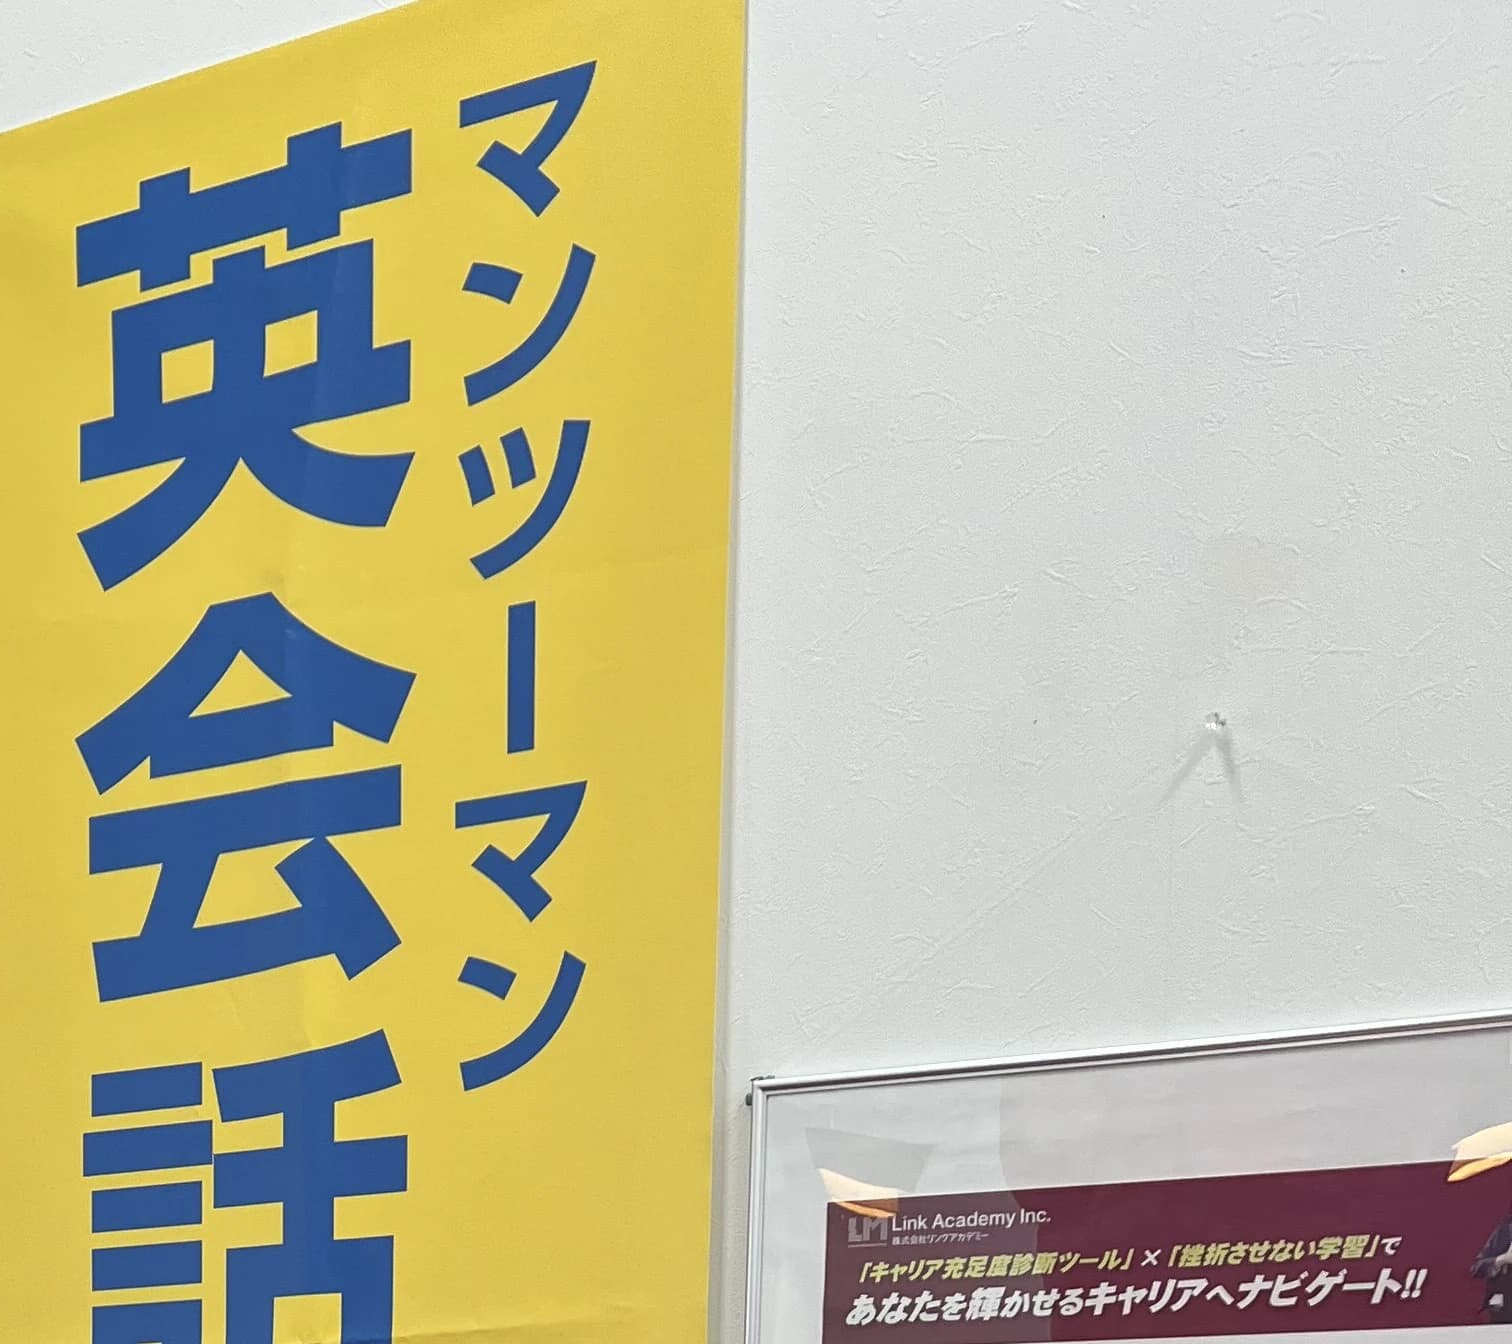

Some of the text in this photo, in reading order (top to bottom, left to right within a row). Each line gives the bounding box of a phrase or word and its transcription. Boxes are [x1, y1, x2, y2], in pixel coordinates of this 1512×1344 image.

[455, 60, 597, 1091] マンツーマン
[892, 1213, 927, 1232] Link
[932, 1210, 1016, 1230] Academy
[1019, 1209, 1052, 1224] Inc.
[892, 1232, 989, 1246] 株式会社リンクアカデミー
